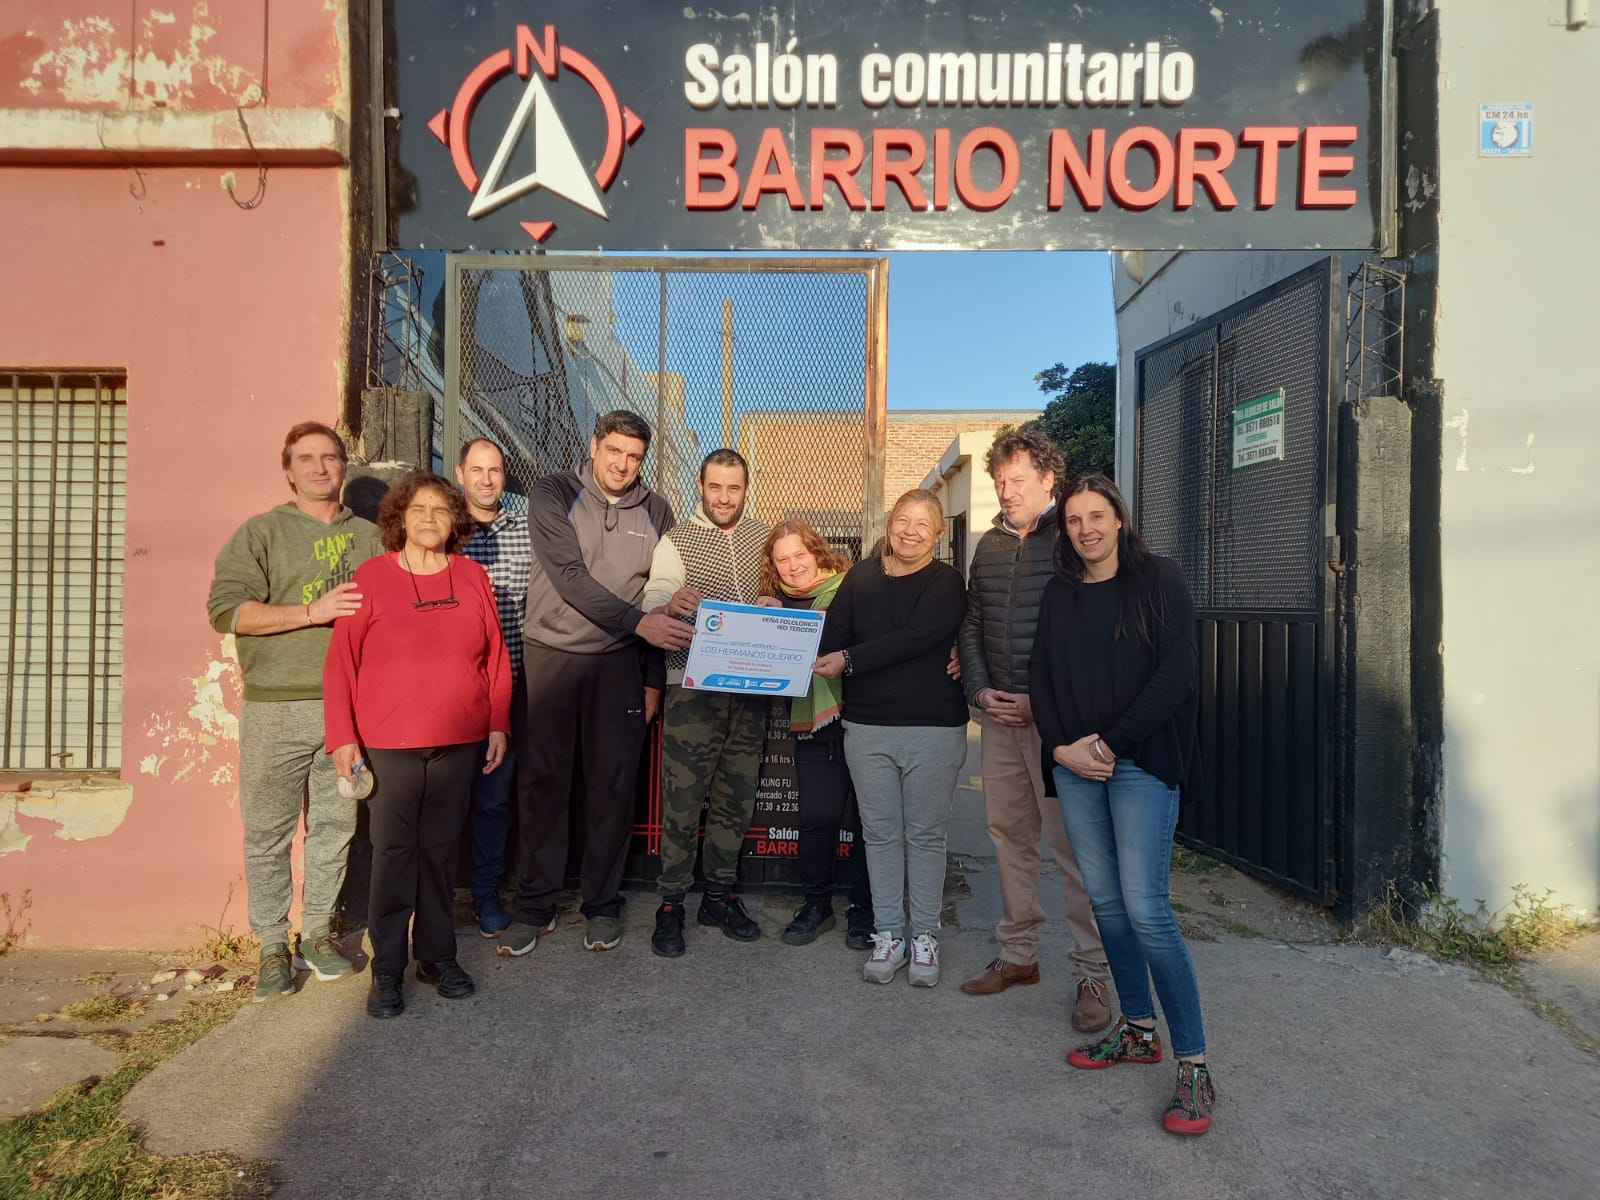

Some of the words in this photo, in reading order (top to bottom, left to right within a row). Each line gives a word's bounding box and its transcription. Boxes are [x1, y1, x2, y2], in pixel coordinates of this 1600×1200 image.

[516, 24, 558, 80] N
[684, 37, 838, 109] Salón
[860, 42, 1195, 109] comunitario
[1502, 111, 1515, 119] 24
[684, 127, 1022, 211] BARRIO
[1047, 126, 1358, 211] NORTE
[1246, 420, 1258, 433] 3571
[701, 645, 718, 655] LOS
[718, 647, 766, 659] HERMANOS
[760, 778, 780, 788] KUNG
[782, 779, 792, 788] FU
[769, 827, 799, 840] Salón
[839, 829, 854, 842] ita
[757, 841, 799, 855] BARR
